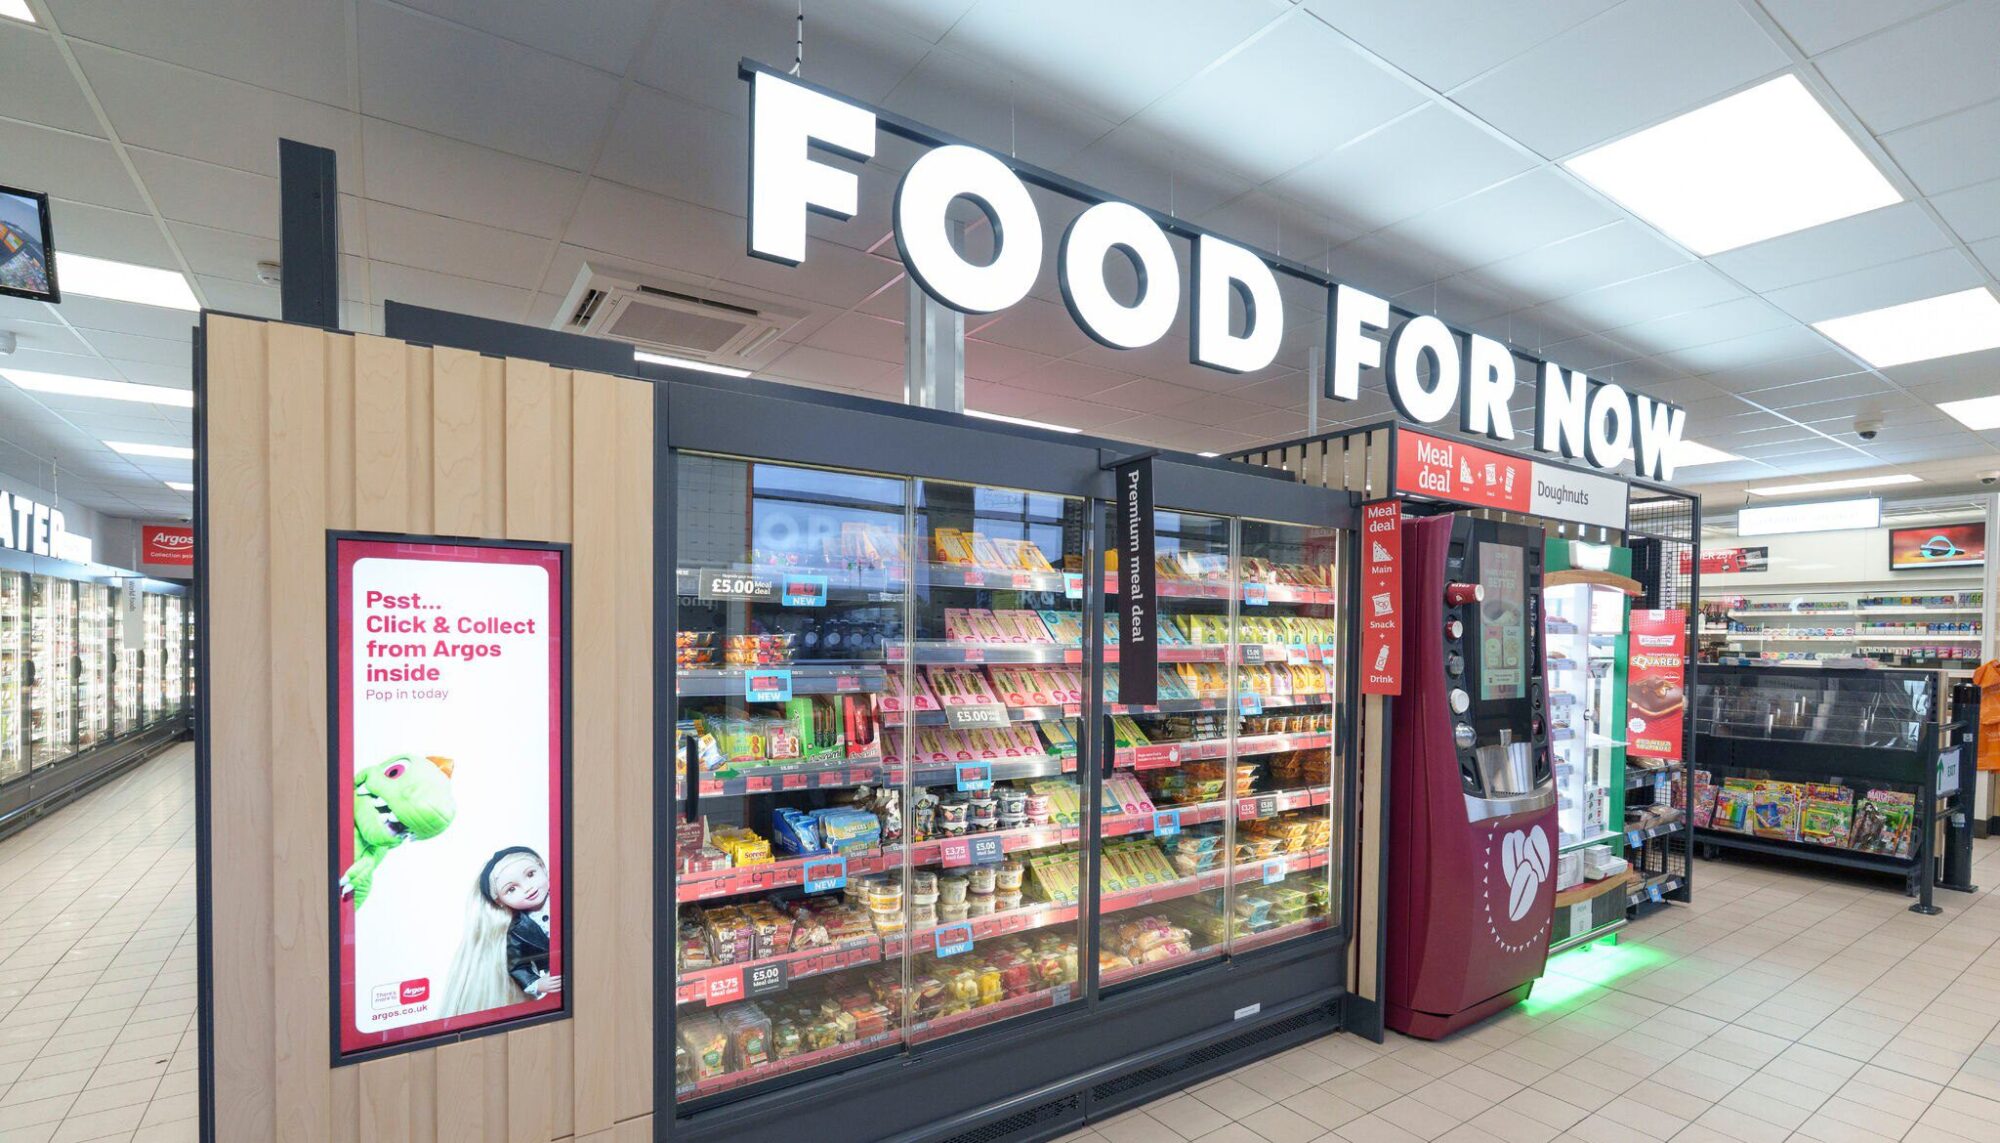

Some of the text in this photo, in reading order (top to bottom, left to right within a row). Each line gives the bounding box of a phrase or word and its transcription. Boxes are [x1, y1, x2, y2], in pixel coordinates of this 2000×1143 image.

[752, 70, 1686, 481] FOOD FOR NOW
[1418, 440, 1453, 468] Meal
[1418, 466, 1450, 493] deal
[1537, 480, 1589, 505] Doughnuts
[1368, 504, 1396, 519] Meal
[1369, 519, 1395, 533] deal
[153, 532, 194, 546] Argos
[1128, 469, 1145, 643] Premium meal deal
[1371, 566, 1392, 574] Main
[712, 578, 754, 594] £5.00
[754, 581, 772, 589] Meal
[754, 587, 770, 595] deal
[366, 591, 442, 610] Psst...
[792, 597, 816, 606] NEW
[366, 615, 536, 634] Click & Collect
[1370, 620, 1395, 629] Snack
[366, 640, 502, 661] from Argos
[1632, 656, 1681, 670] SQUARED
[367, 664, 440, 682] inside
[1370, 675, 1393, 683] Drink
[366, 688, 449, 701] Pop in today
[757, 692, 781, 700] NEW
[957, 711, 988, 722] £5.00
[966, 781, 984, 789] NEW
[945, 846, 966, 855] £3.75
[976, 842, 995, 851] £5.00
[814, 879, 837, 890] NEW
[945, 945, 965, 954] NEW
[753, 967, 779, 982] £5.00
[404, 986, 426, 996] Argos
[711, 977, 738, 991] £3.75
[371, 1004, 428, 1021] argos.co.uk
